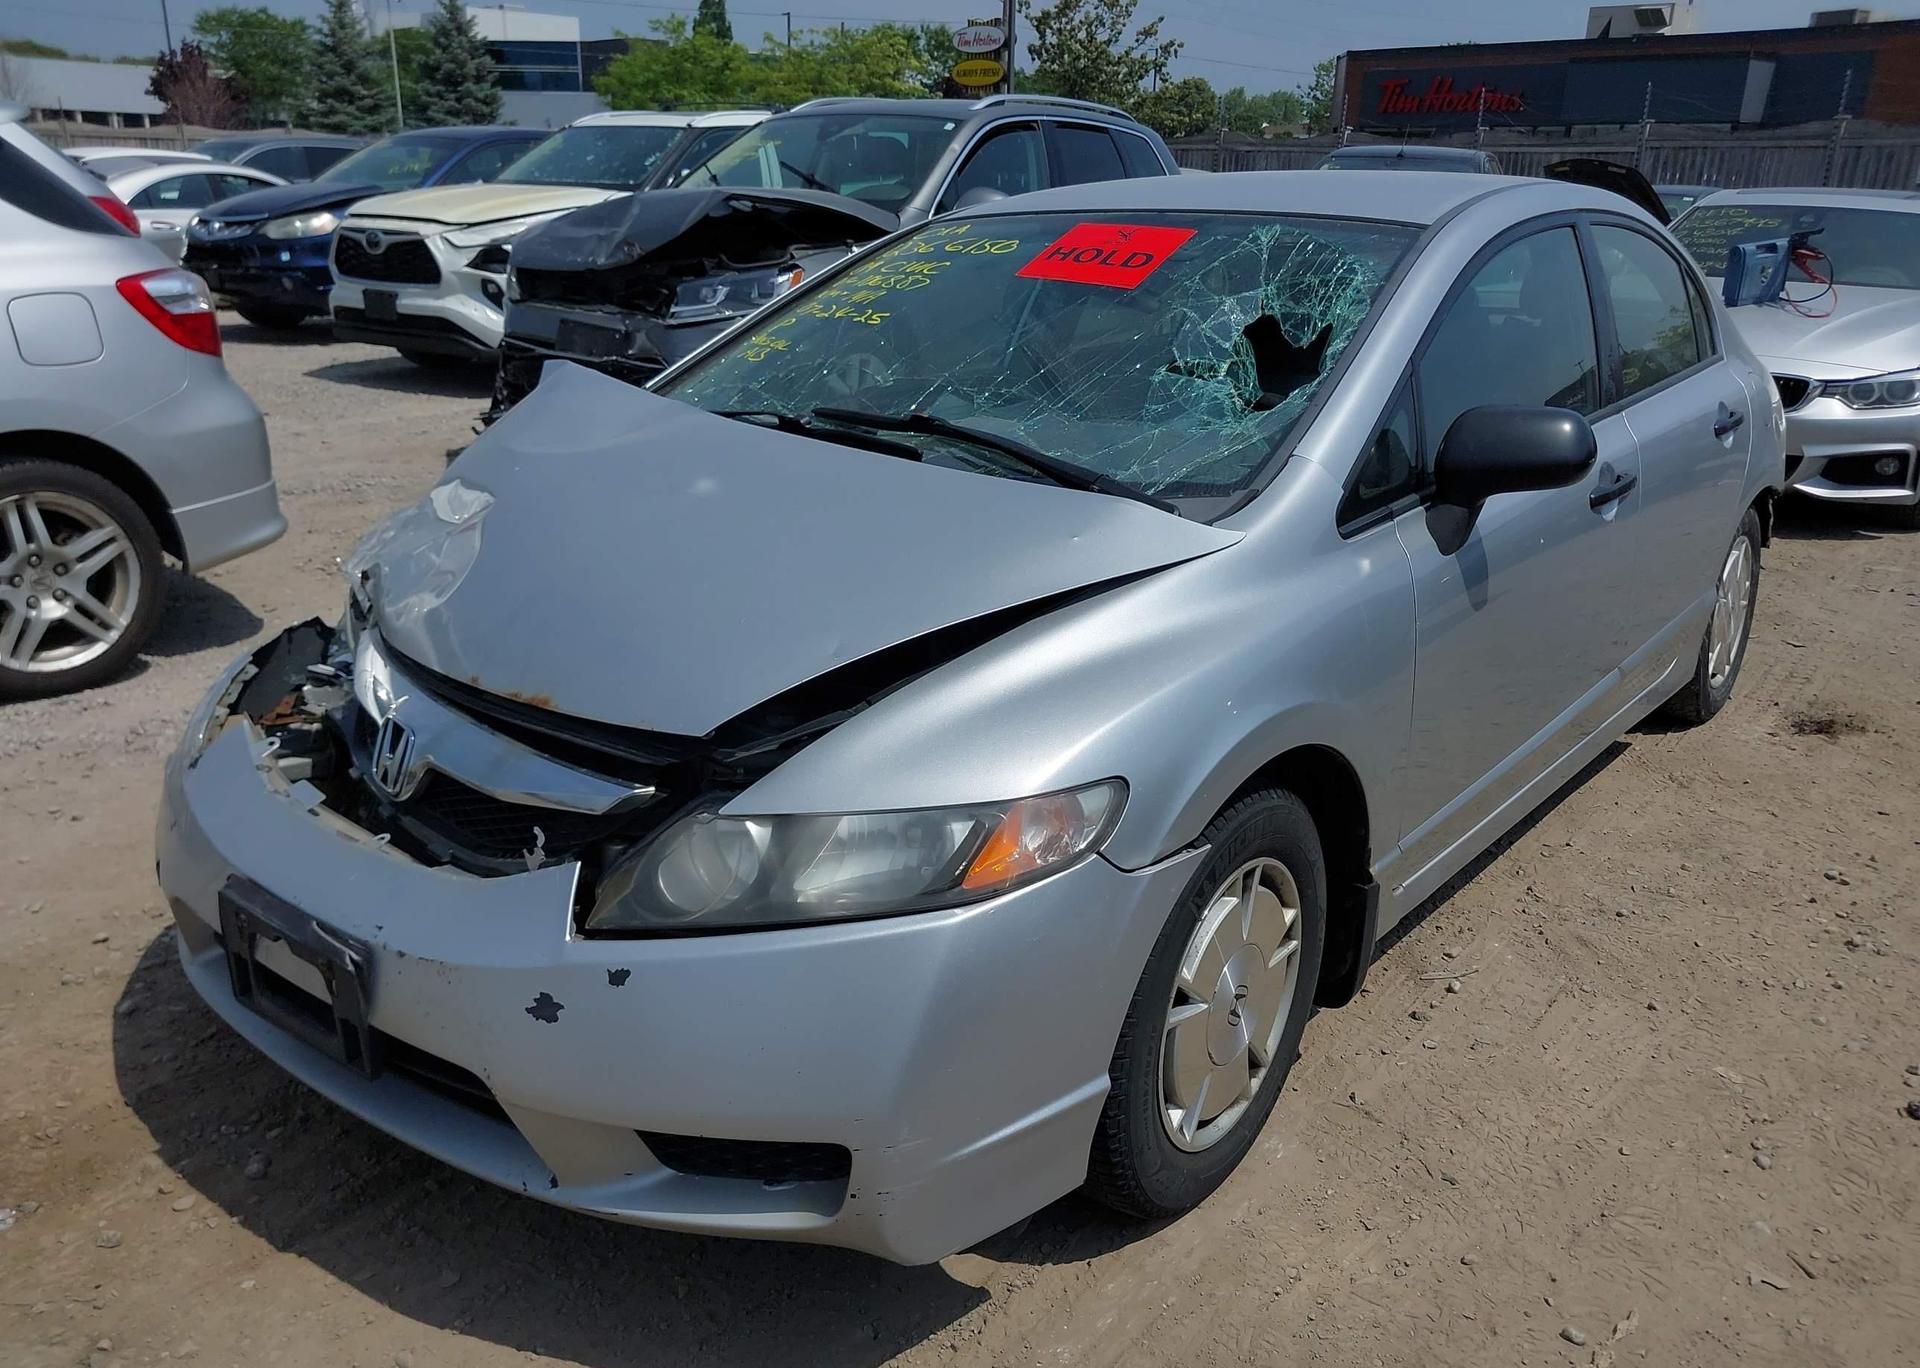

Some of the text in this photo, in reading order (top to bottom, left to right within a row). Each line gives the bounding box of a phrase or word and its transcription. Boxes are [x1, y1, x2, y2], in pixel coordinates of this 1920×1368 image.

[957, 32, 971, 47] Tim
[1378, 75, 1522, 114] Tim Hortons
[1046, 246, 1154, 269] HOLD
